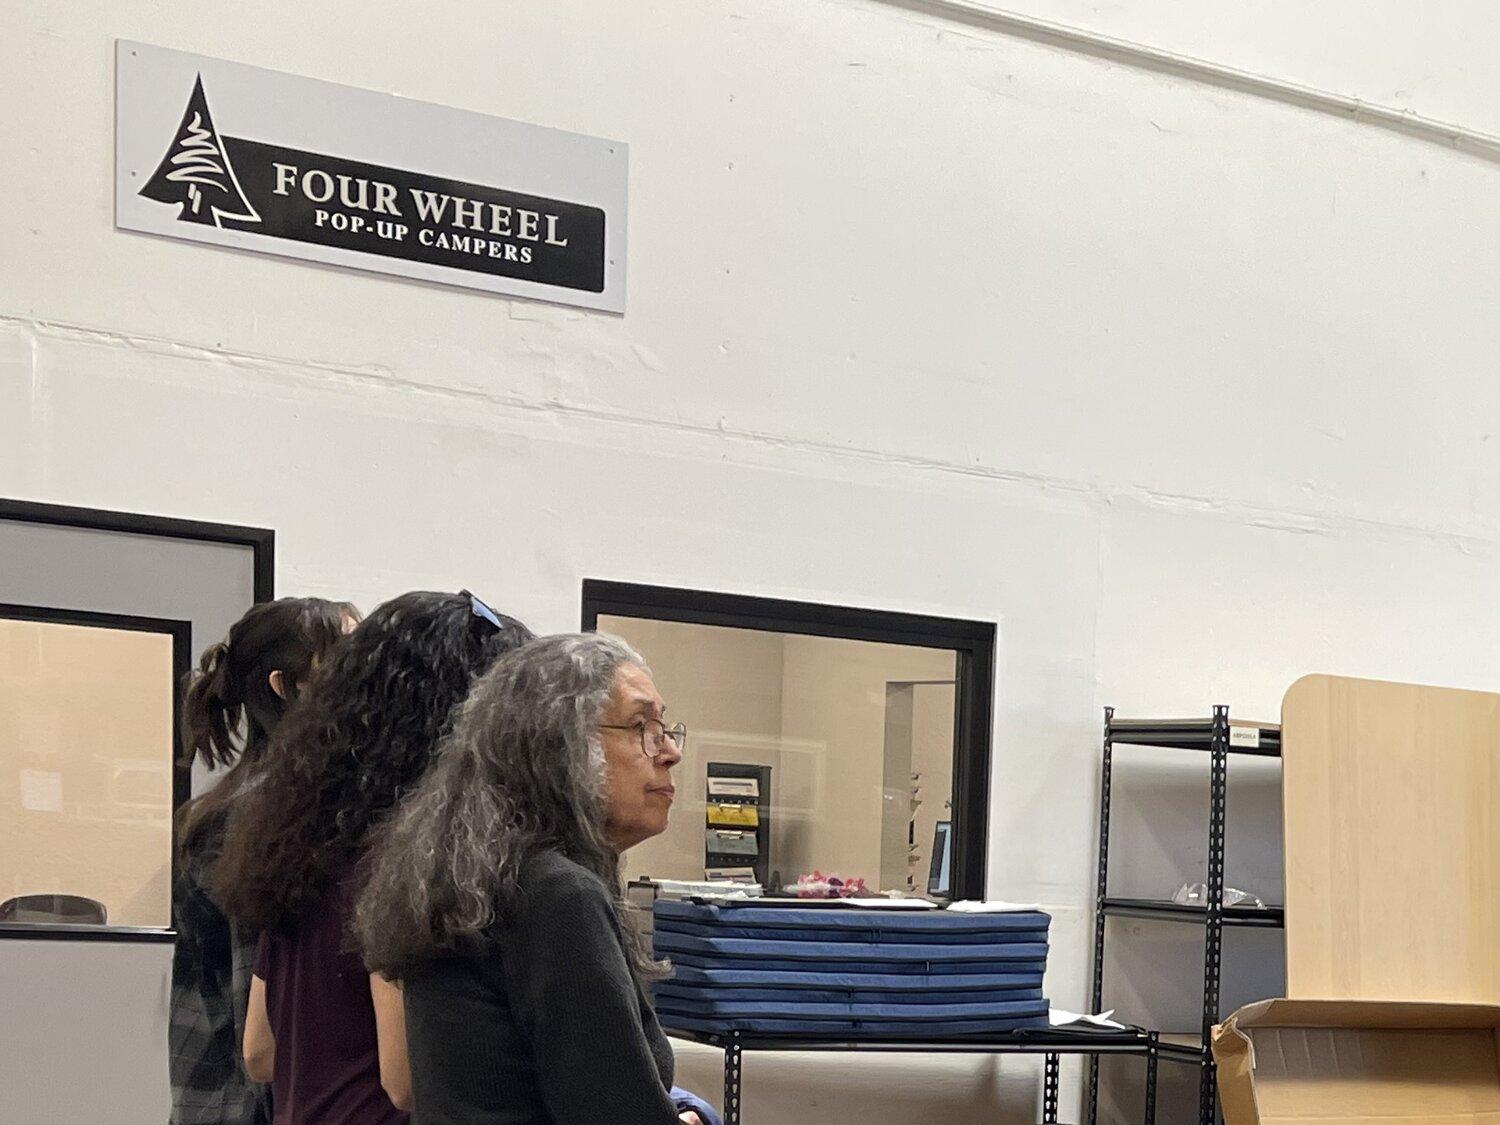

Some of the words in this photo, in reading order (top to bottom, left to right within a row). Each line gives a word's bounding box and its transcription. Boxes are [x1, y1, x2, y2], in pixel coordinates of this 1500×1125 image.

[273, 162, 403, 217] FOUR
[409, 188, 569, 247] WHEEL
[314, 208, 409, 242] POP-UP
[418, 228, 534, 264] CAMPERS
